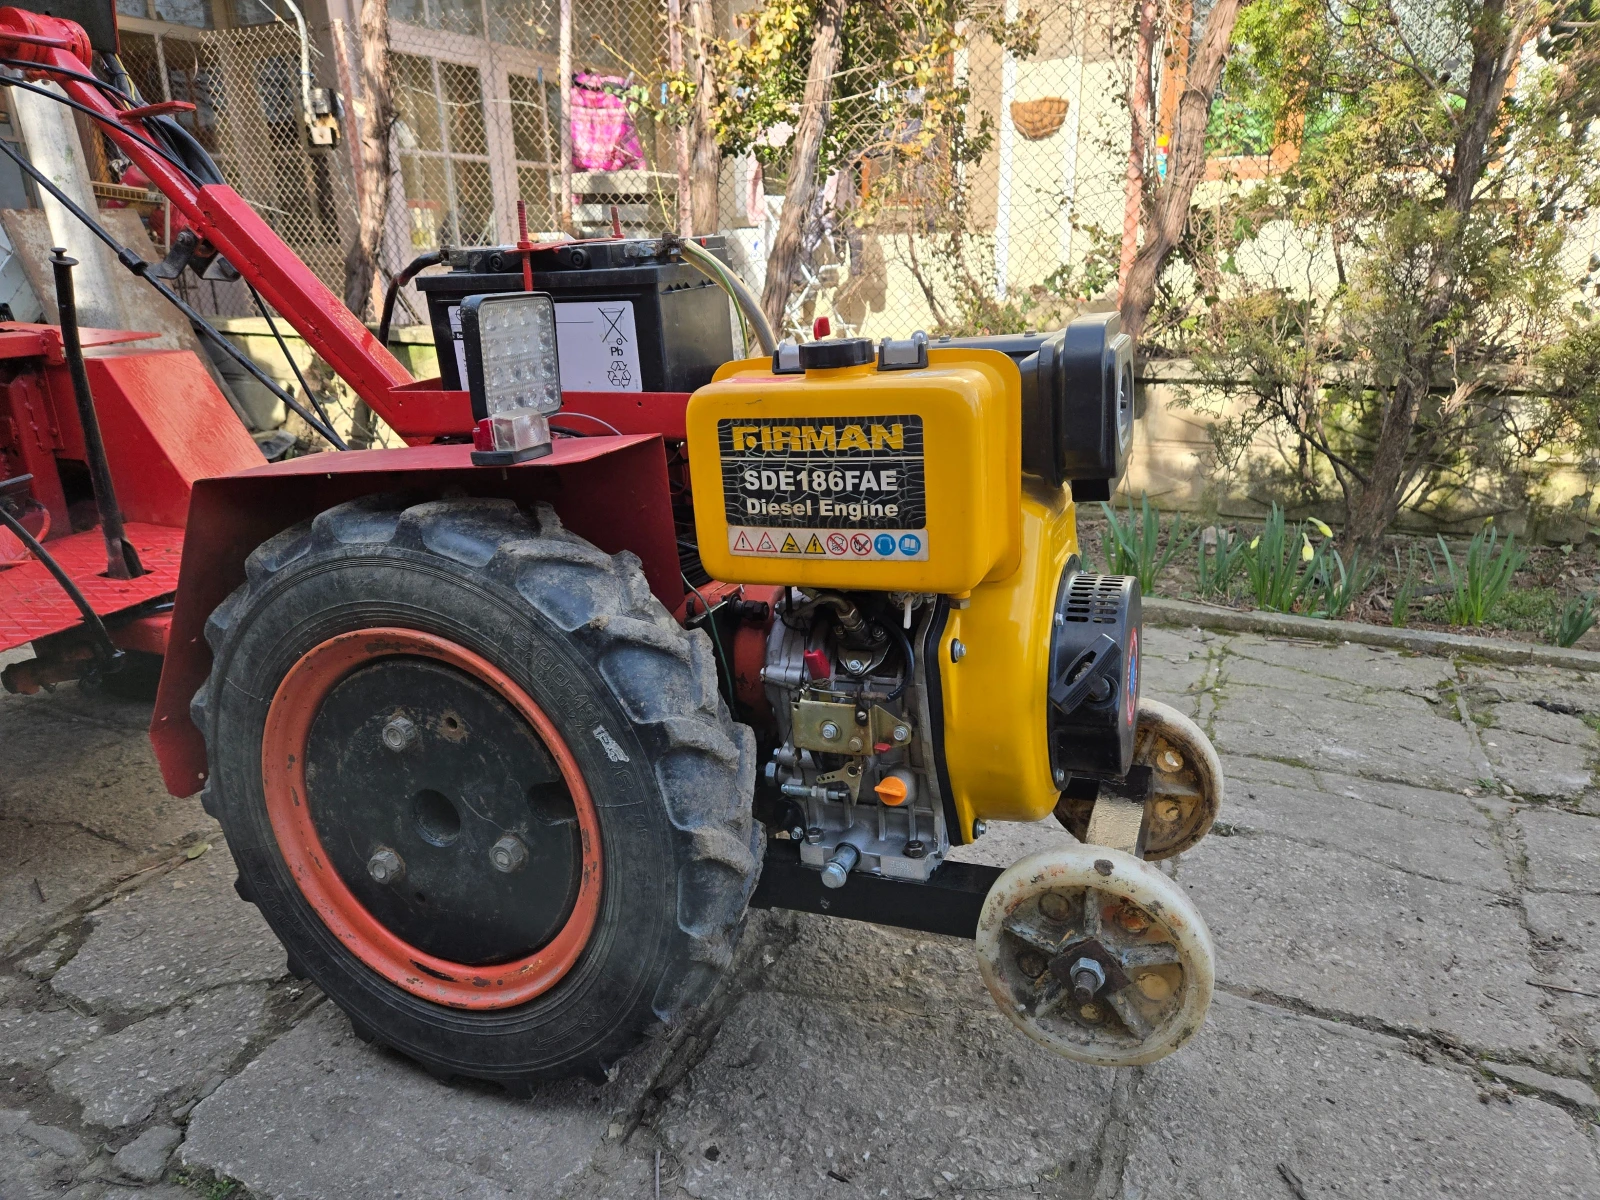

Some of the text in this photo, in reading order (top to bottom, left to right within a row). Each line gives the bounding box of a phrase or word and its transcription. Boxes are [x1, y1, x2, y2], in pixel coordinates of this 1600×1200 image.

[610, 346, 624, 357] Pb
[732, 423, 904, 451] FIRMAN
[744, 470, 897, 491] SDE186FAE
[747, 499, 899, 521] Diesel Engine
